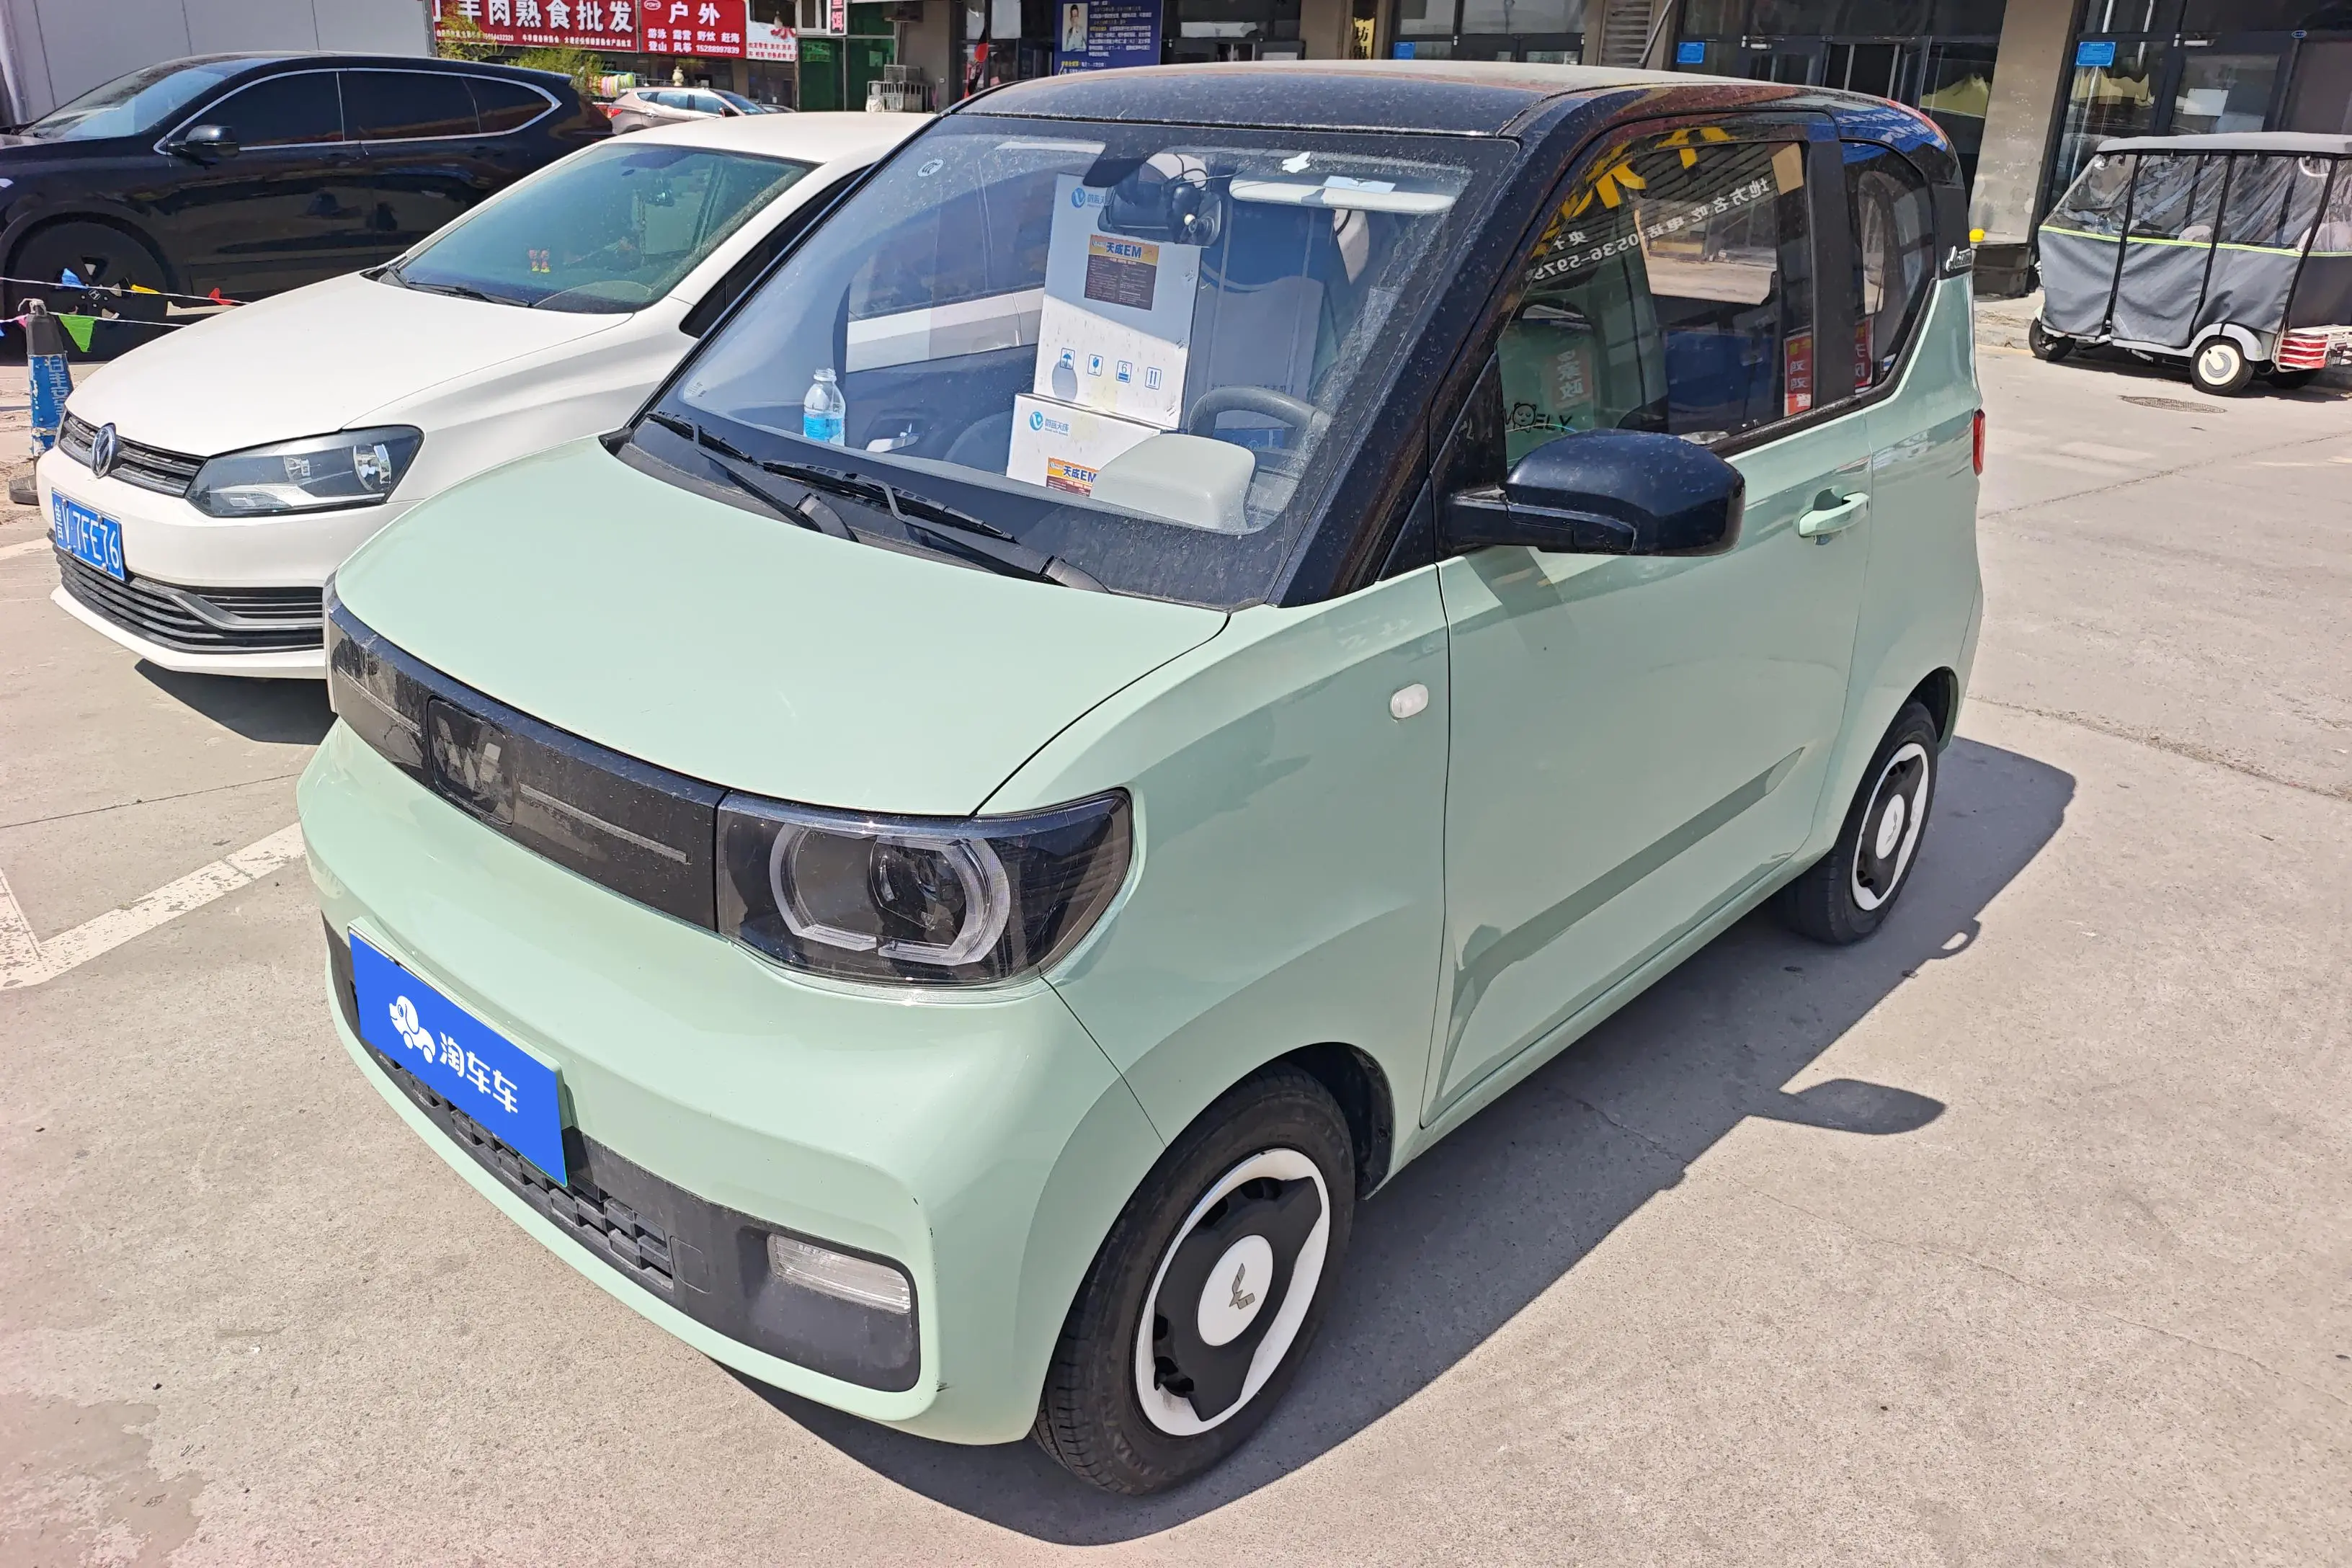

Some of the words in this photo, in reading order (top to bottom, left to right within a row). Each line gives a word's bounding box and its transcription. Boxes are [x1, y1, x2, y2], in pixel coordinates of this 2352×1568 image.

[668, 1, 721, 27] 户外
[649, 41, 667, 52] 登山
[1106, 241, 1142, 259] 天成EM
[1121, 362, 1128, 373] 6
